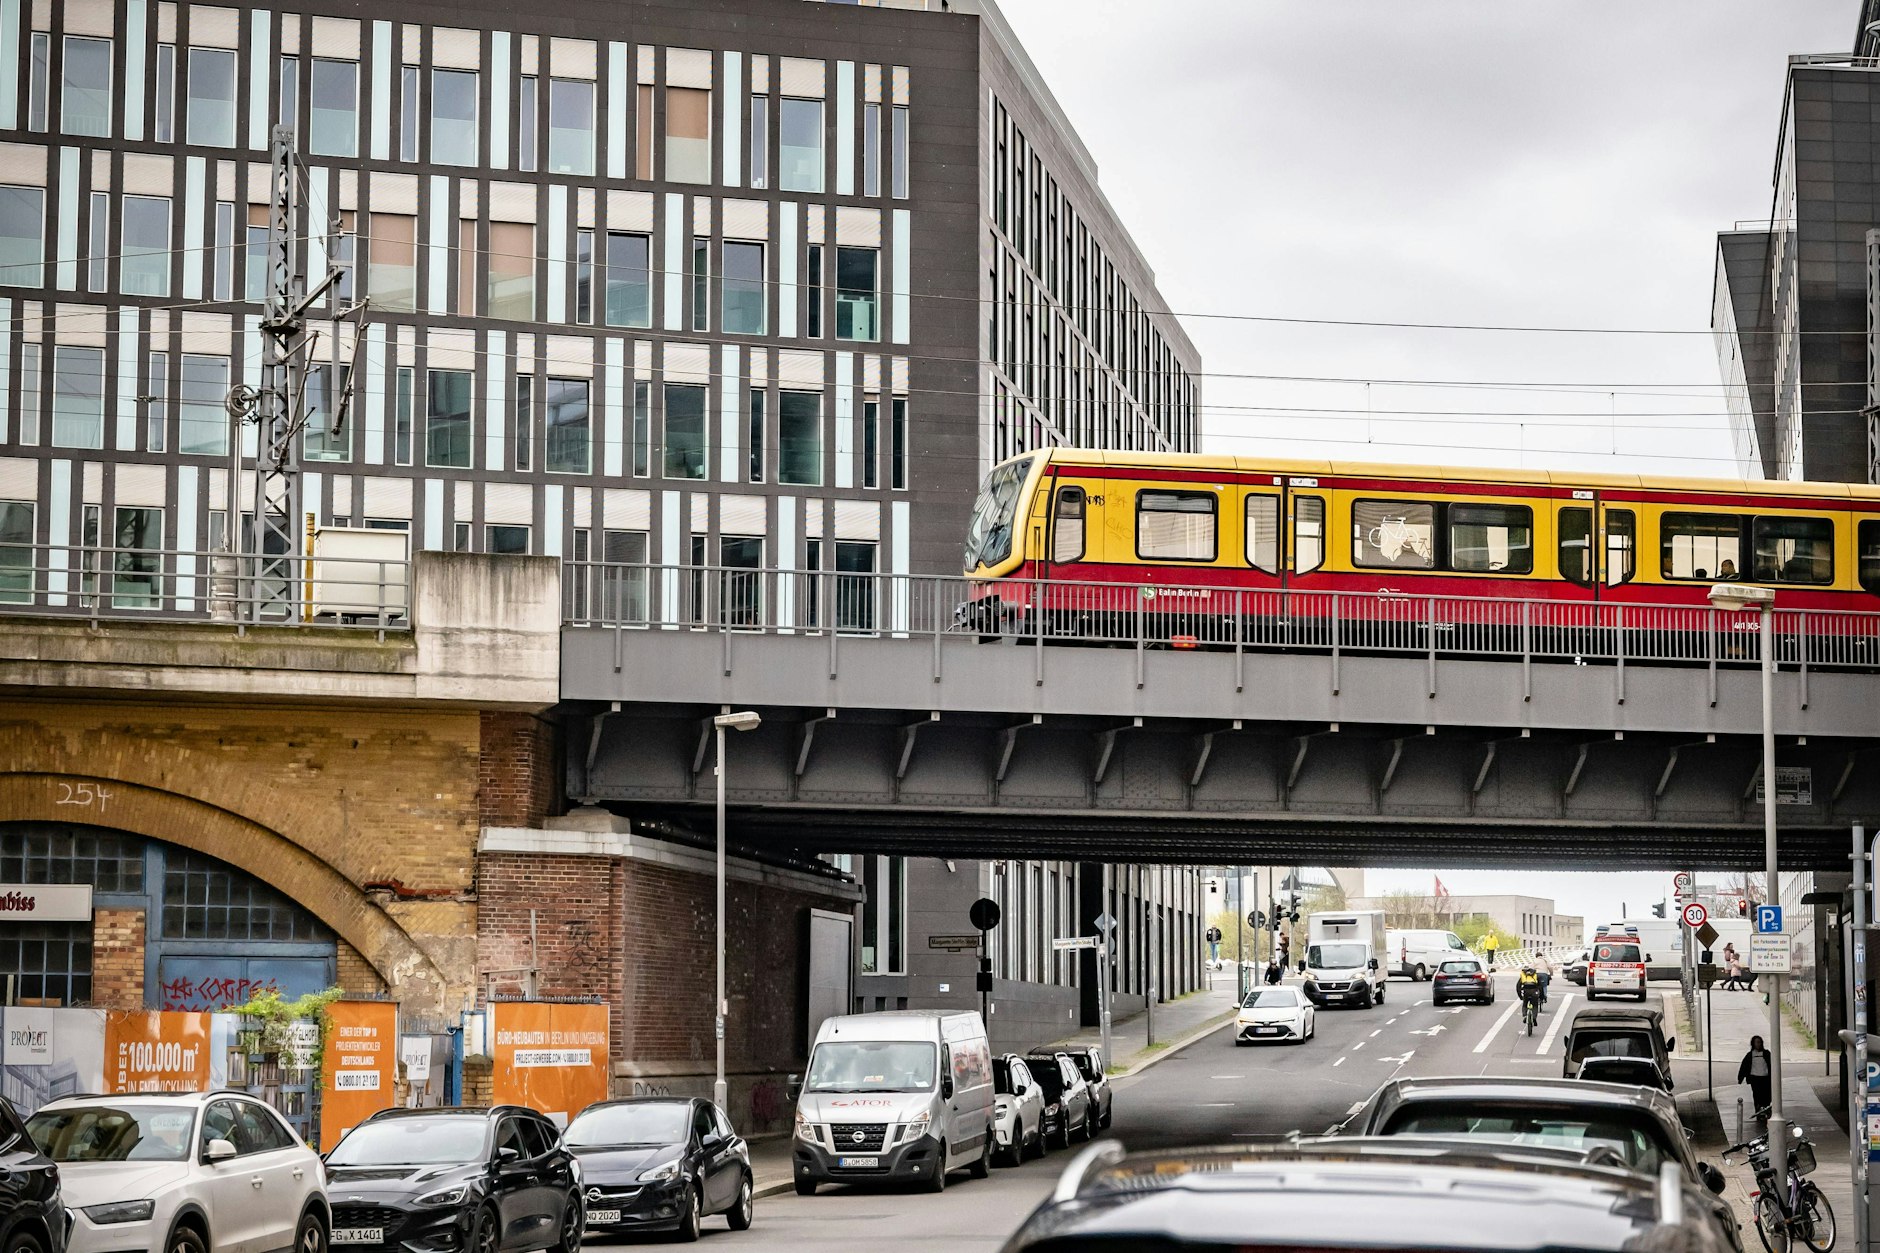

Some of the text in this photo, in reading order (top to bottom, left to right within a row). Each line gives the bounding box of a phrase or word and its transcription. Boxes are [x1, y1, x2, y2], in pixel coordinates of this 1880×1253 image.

[1178, 589, 1200, 597] Berln
[56, 783, 113, 812] 254
[1677, 877, 1689, 886] 50
[1688, 909, 1703, 920] 30
[1762, 910, 1775, 930] P
[340, 1026, 378, 1037] EINER DER TOP 10
[497, 1028, 545, 1045] BÜRO-NEUBAUTEN
[551, 1032, 569, 1045] BERLIN
[570, 1032, 580, 1044] UND
[581, 1032, 606, 1044] UMGEBUNG
[129, 1042, 181, 1072] 100.000
[341, 1056, 375, 1066] DEUTSCHLANDS
[598, 1211, 619, 1220] 2020
[349, 1230, 355, 1240] X
[357, 1229, 381, 1240] 1401
